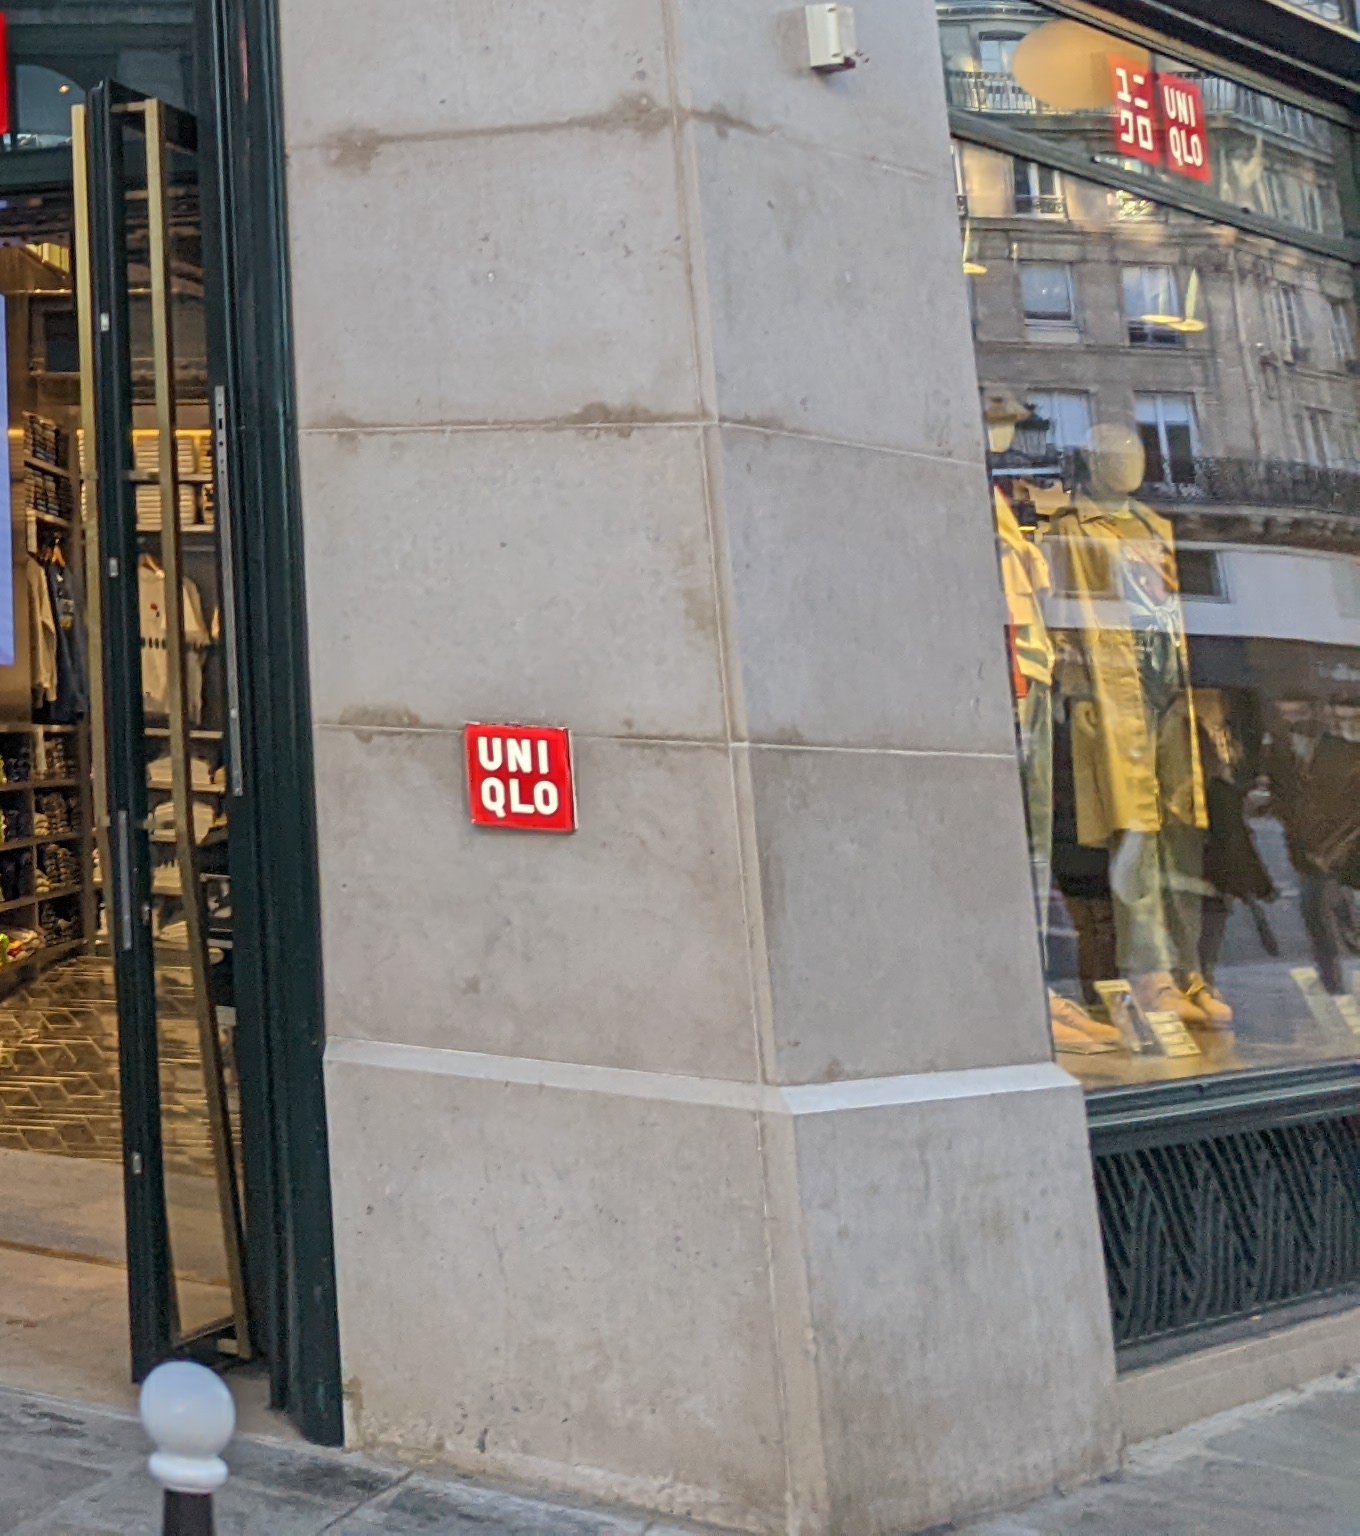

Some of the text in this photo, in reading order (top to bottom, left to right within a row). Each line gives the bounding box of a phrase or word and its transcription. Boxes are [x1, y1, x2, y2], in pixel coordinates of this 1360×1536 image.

[1163, 85, 1196, 127] UNI
[1169, 126, 1203, 166] QLO
[477, 736, 549, 774] UNI
[481, 776, 559, 818] QLO
